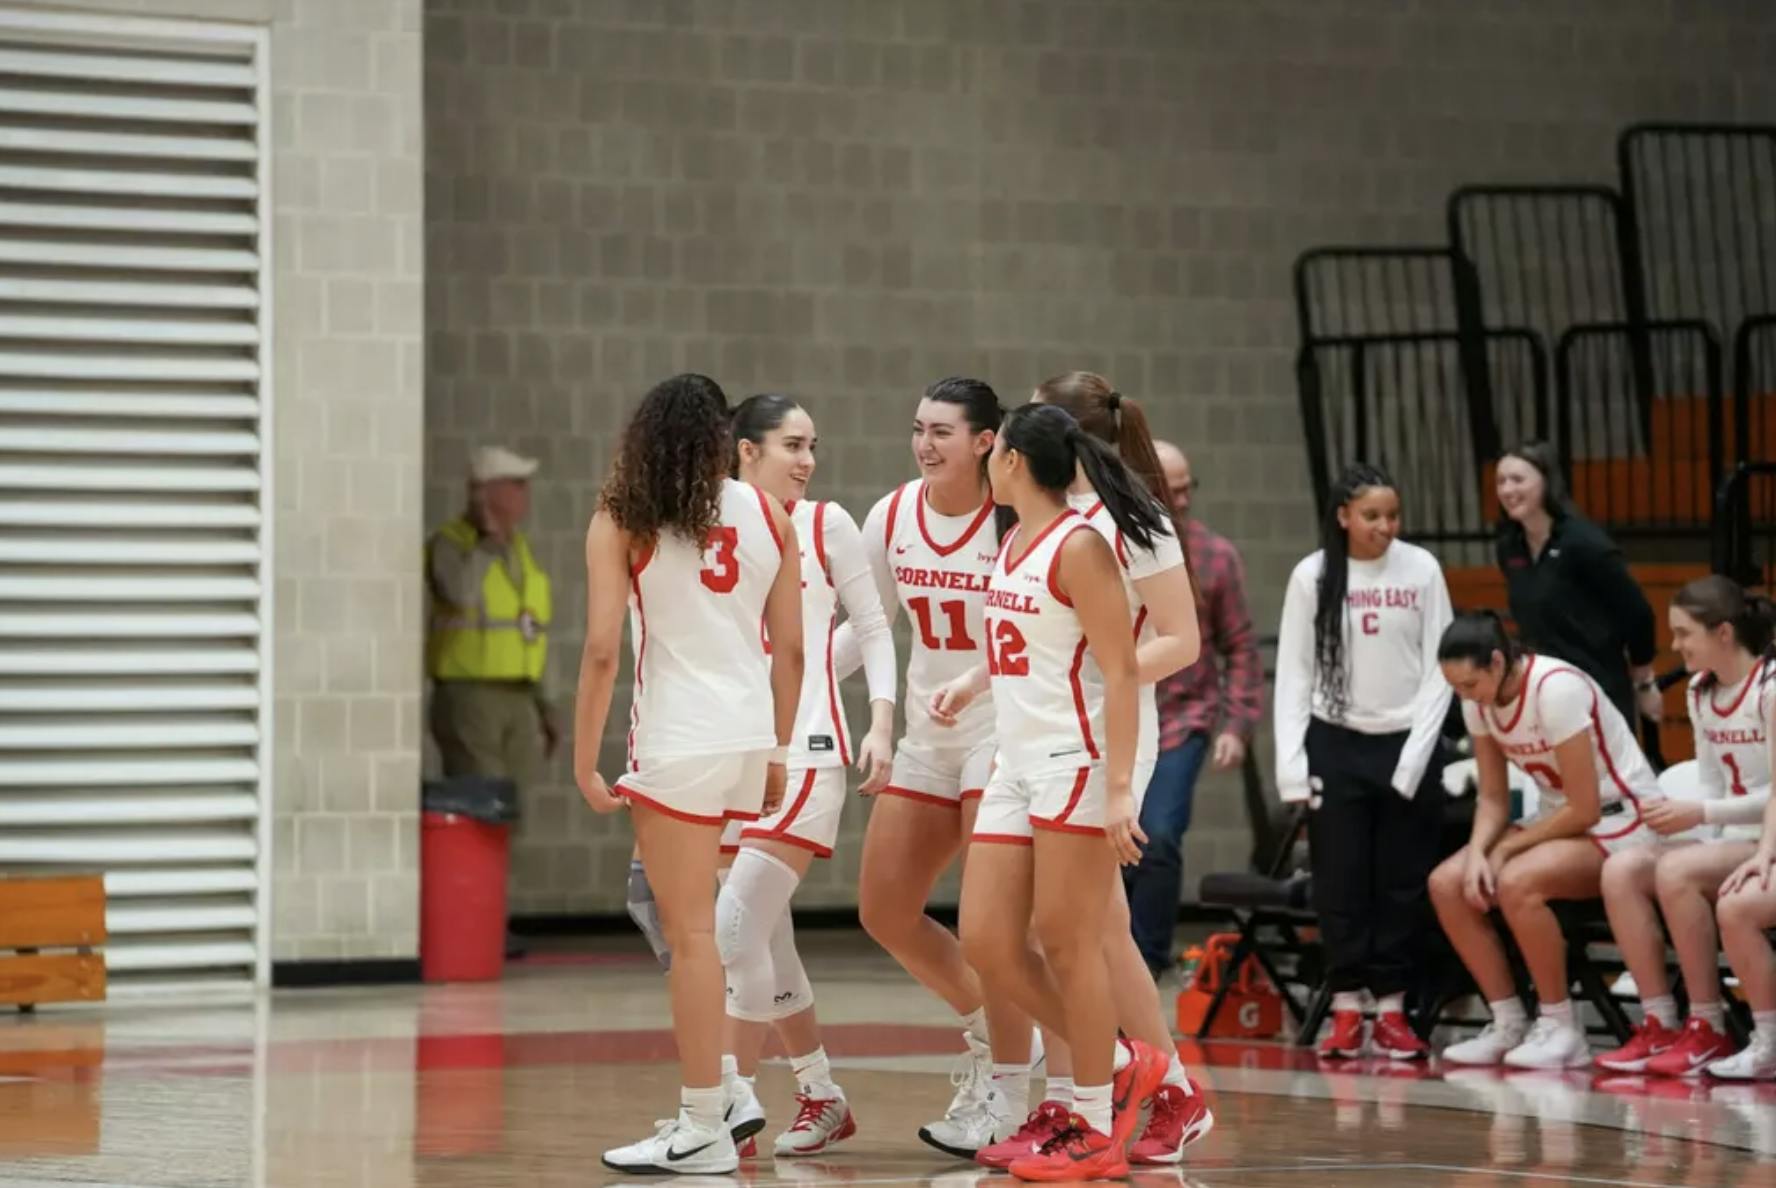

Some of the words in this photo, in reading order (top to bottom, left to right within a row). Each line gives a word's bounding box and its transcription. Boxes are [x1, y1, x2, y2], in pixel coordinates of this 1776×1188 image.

[700, 526, 740, 593] 3
[906, 596, 977, 651] 11
[1362, 612, 1379, 635] C
[1239, 1002, 1260, 1028] G
